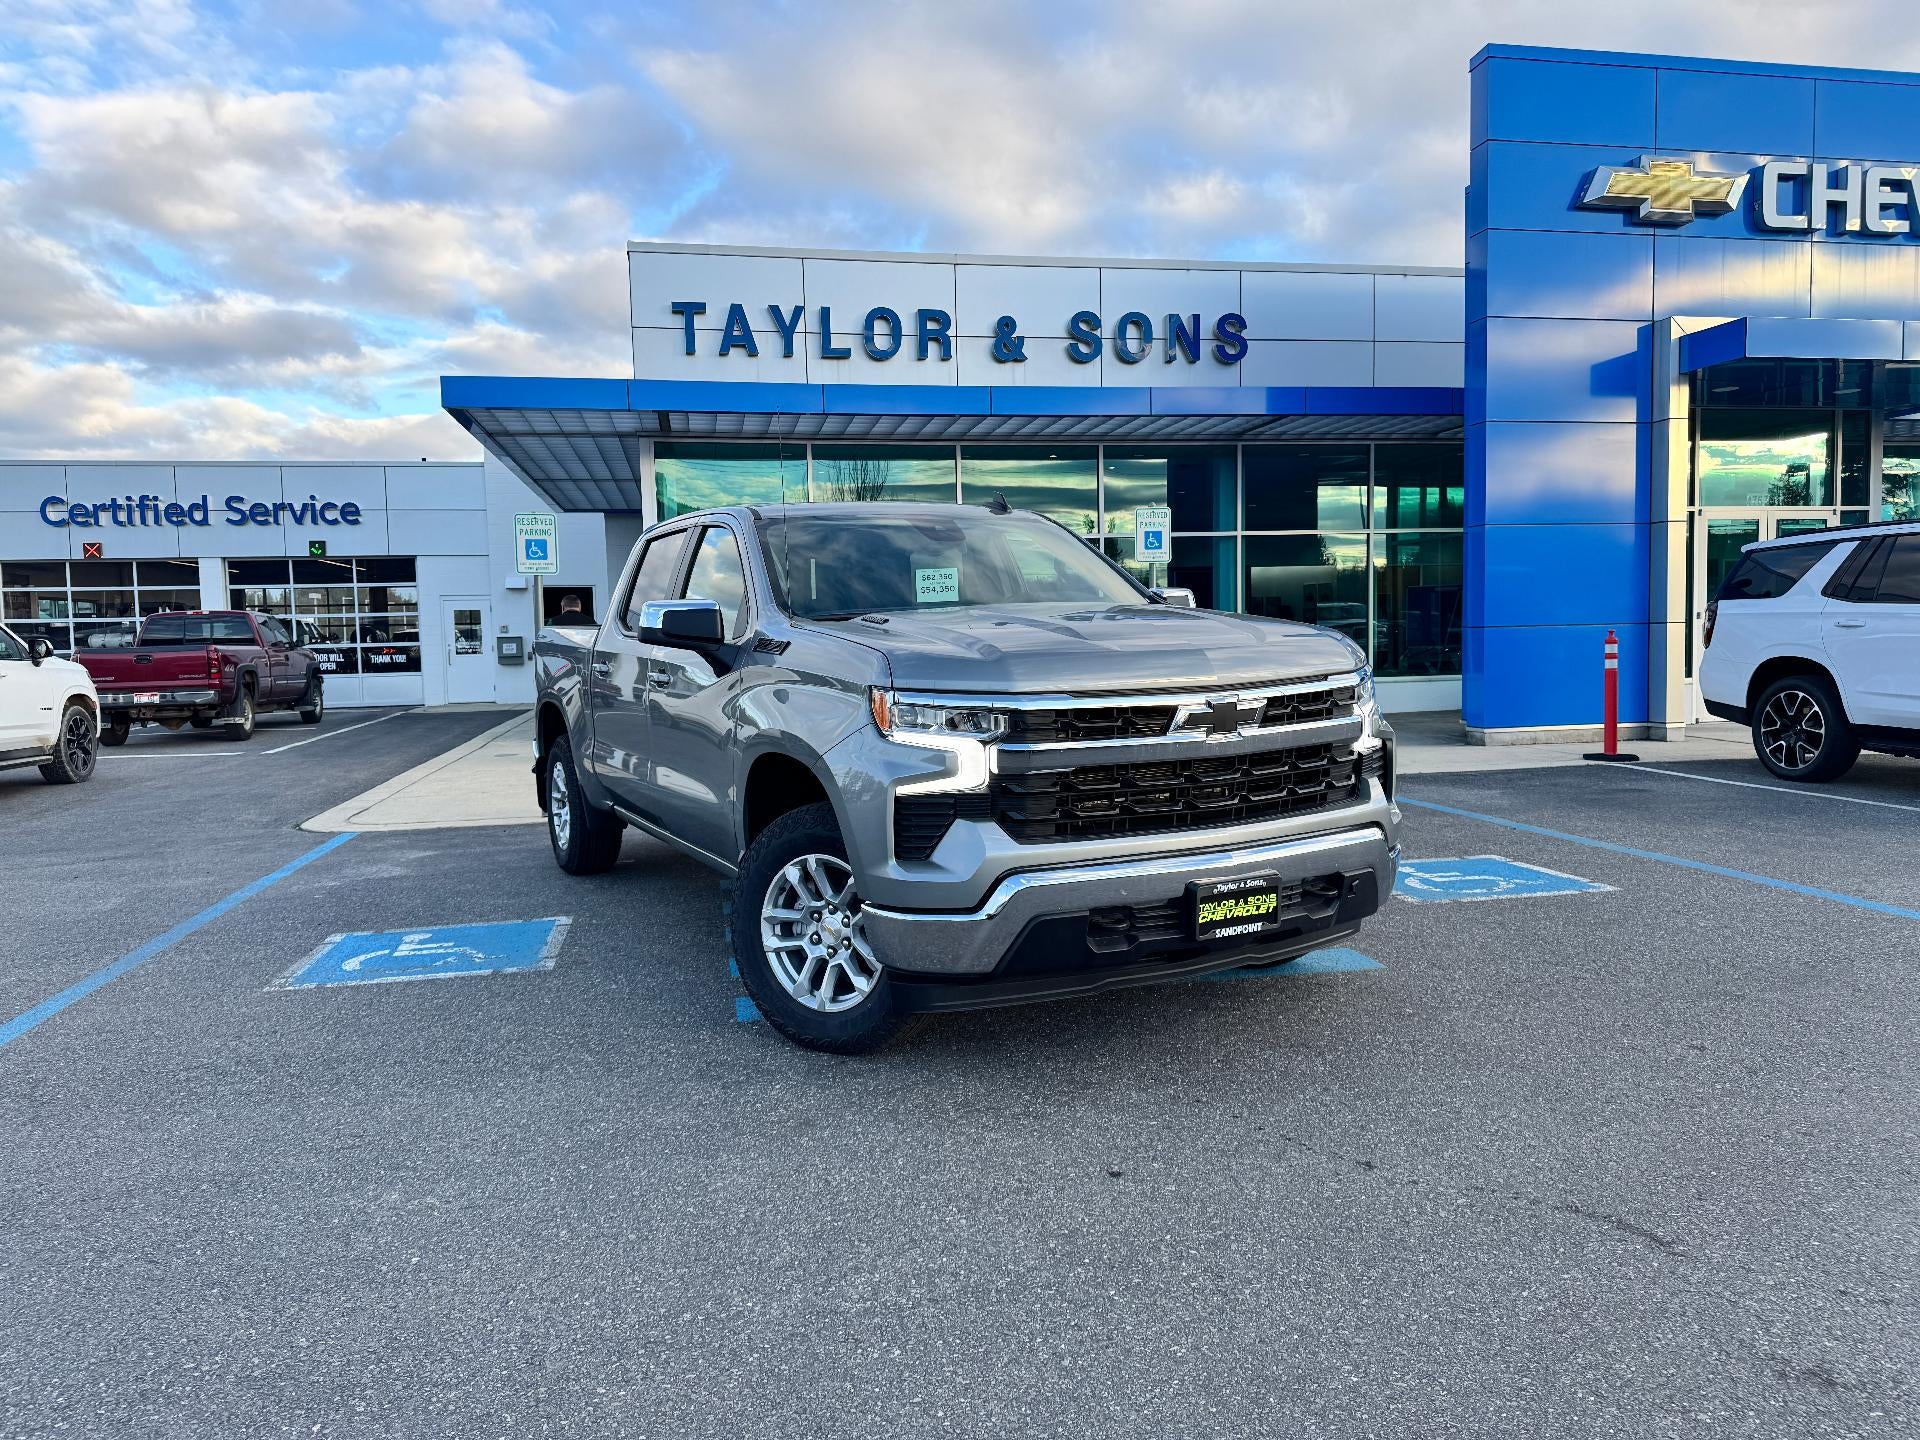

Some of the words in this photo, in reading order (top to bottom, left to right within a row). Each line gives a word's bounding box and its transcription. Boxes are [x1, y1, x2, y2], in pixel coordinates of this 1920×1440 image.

[1763, 162, 1920, 232] CHE
[671, 301, 952, 361] TAYLOR
[992, 314, 1027, 363] &
[1067, 311, 1249, 365] SONS
[39, 494, 211, 527] Certified
[224, 494, 362, 526] Service
[1137, 511, 1168, 519] RESERVED
[517, 517, 553, 526] RESERVED
[1140, 521, 1167, 529] PARKING
[519, 528, 552, 537] PARKING
[920, 585, 956, 595] $54,350
[315, 653, 329, 662] OOR
[329, 653, 345, 662] WILL
[371, 654, 391, 664] THANK
[392, 653, 407, 663] YOU!
[319, 661, 337, 671] OPEN
[1217, 882, 1239, 893] Taylor
[1246, 879, 1264, 887] Sons
[1199, 899, 1236, 913] TAYLOR
[1239, 898, 1245, 907] &
[1247, 893, 1277, 904] SONS
[1198, 903, 1277, 923] CHEVROLET
[1215, 922, 1264, 938] SANDPOINT
